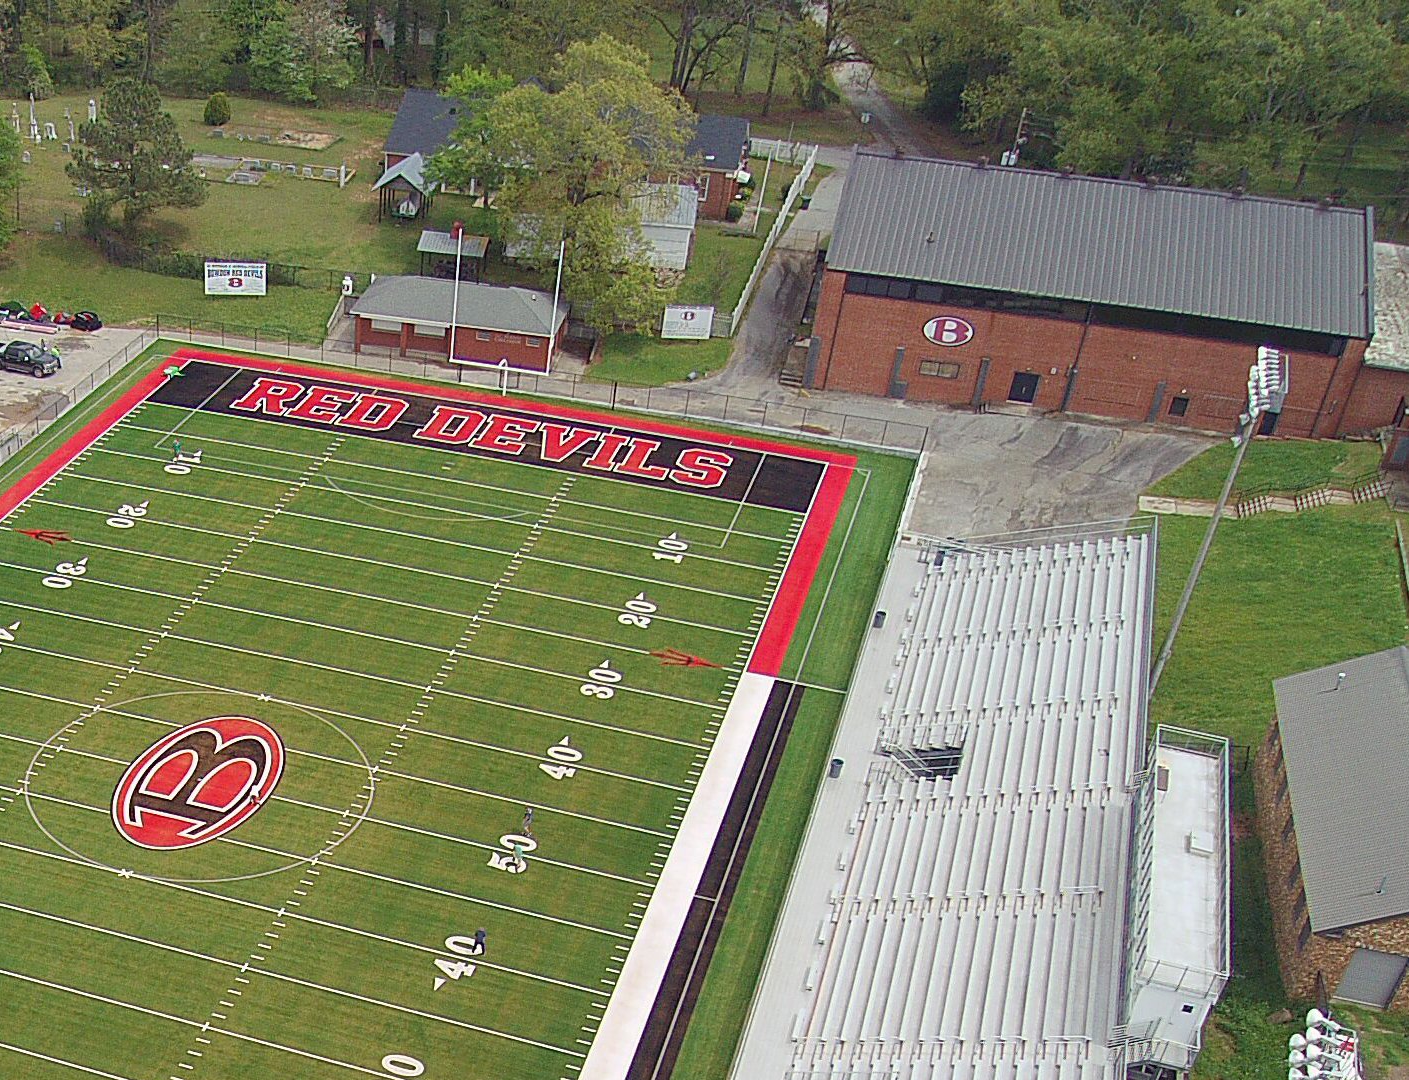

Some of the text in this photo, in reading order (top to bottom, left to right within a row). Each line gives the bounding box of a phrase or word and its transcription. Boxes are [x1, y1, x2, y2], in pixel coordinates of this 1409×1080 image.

[244, 269, 263, 279] DEVILS
[931, 318, 970, 344] B
[229, 377, 734, 489] RED DEVILS
[163, 454, 202, 475] 10
[106, 504, 147, 528] 20
[652, 539, 688, 564] 10
[41, 562, 87, 589] 30
[617, 600, 658, 629] 20
[579, 669, 622, 700] 30
[539, 746, 583, 780] 40
[123, 727, 272, 839] B
[487, 834, 538, 874] 50
[433, 936, 483, 981] 40
